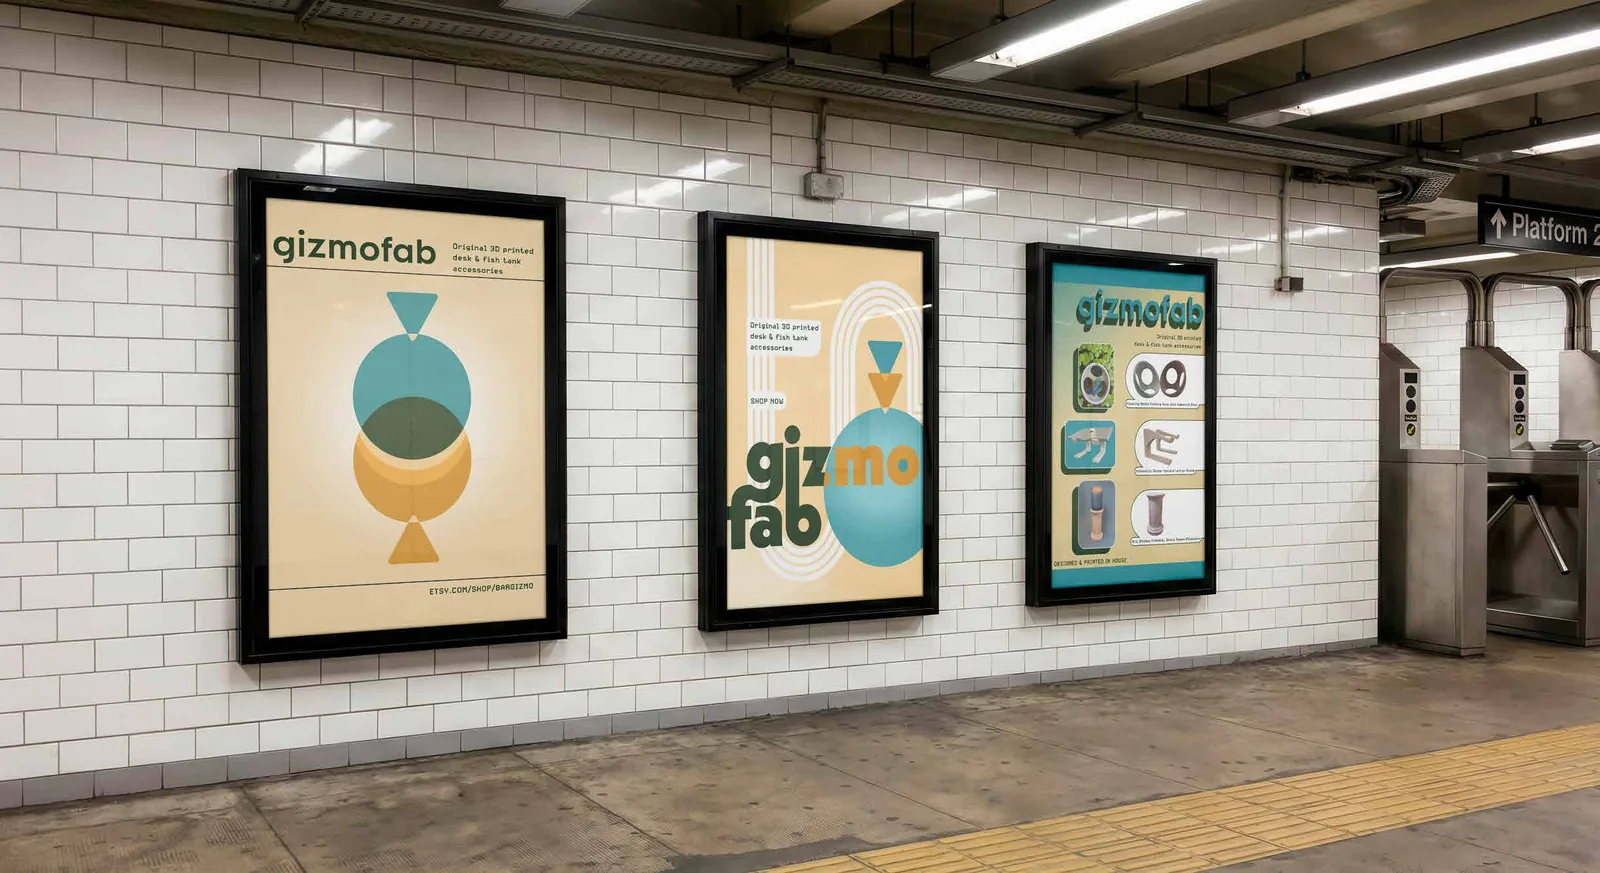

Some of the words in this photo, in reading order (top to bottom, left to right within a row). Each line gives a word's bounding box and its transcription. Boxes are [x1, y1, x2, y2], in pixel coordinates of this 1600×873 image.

[1512, 211, 1588, 245] Platform
[273, 229, 437, 265] gizmofab
[452, 242, 488, 252] Original
[502, 246, 534, 254] printed
[452, 254, 472, 262] desk
[483, 256, 500, 264] fish
[503, 257, 522, 265] tank
[452, 266, 504, 275] accessories
[1075, 287, 1204, 333] gizmofab
[750, 322, 780, 330] Original
[792, 324, 820, 332] printed
[750, 332, 767, 340] desk
[775, 333, 791, 341] fish
[792, 334, 809, 342] tank
[1156, 333, 1176, 341] Original
[749, 344, 794, 352] accessories
[750, 397, 768, 405] SHOP
[769, 397, 784, 405] NOW
[746, 424, 920, 503] gizmo
[726, 484, 822, 550] fab
[429, 582, 534, 596] ETSY.COM/SHOP/BARGIZMO
